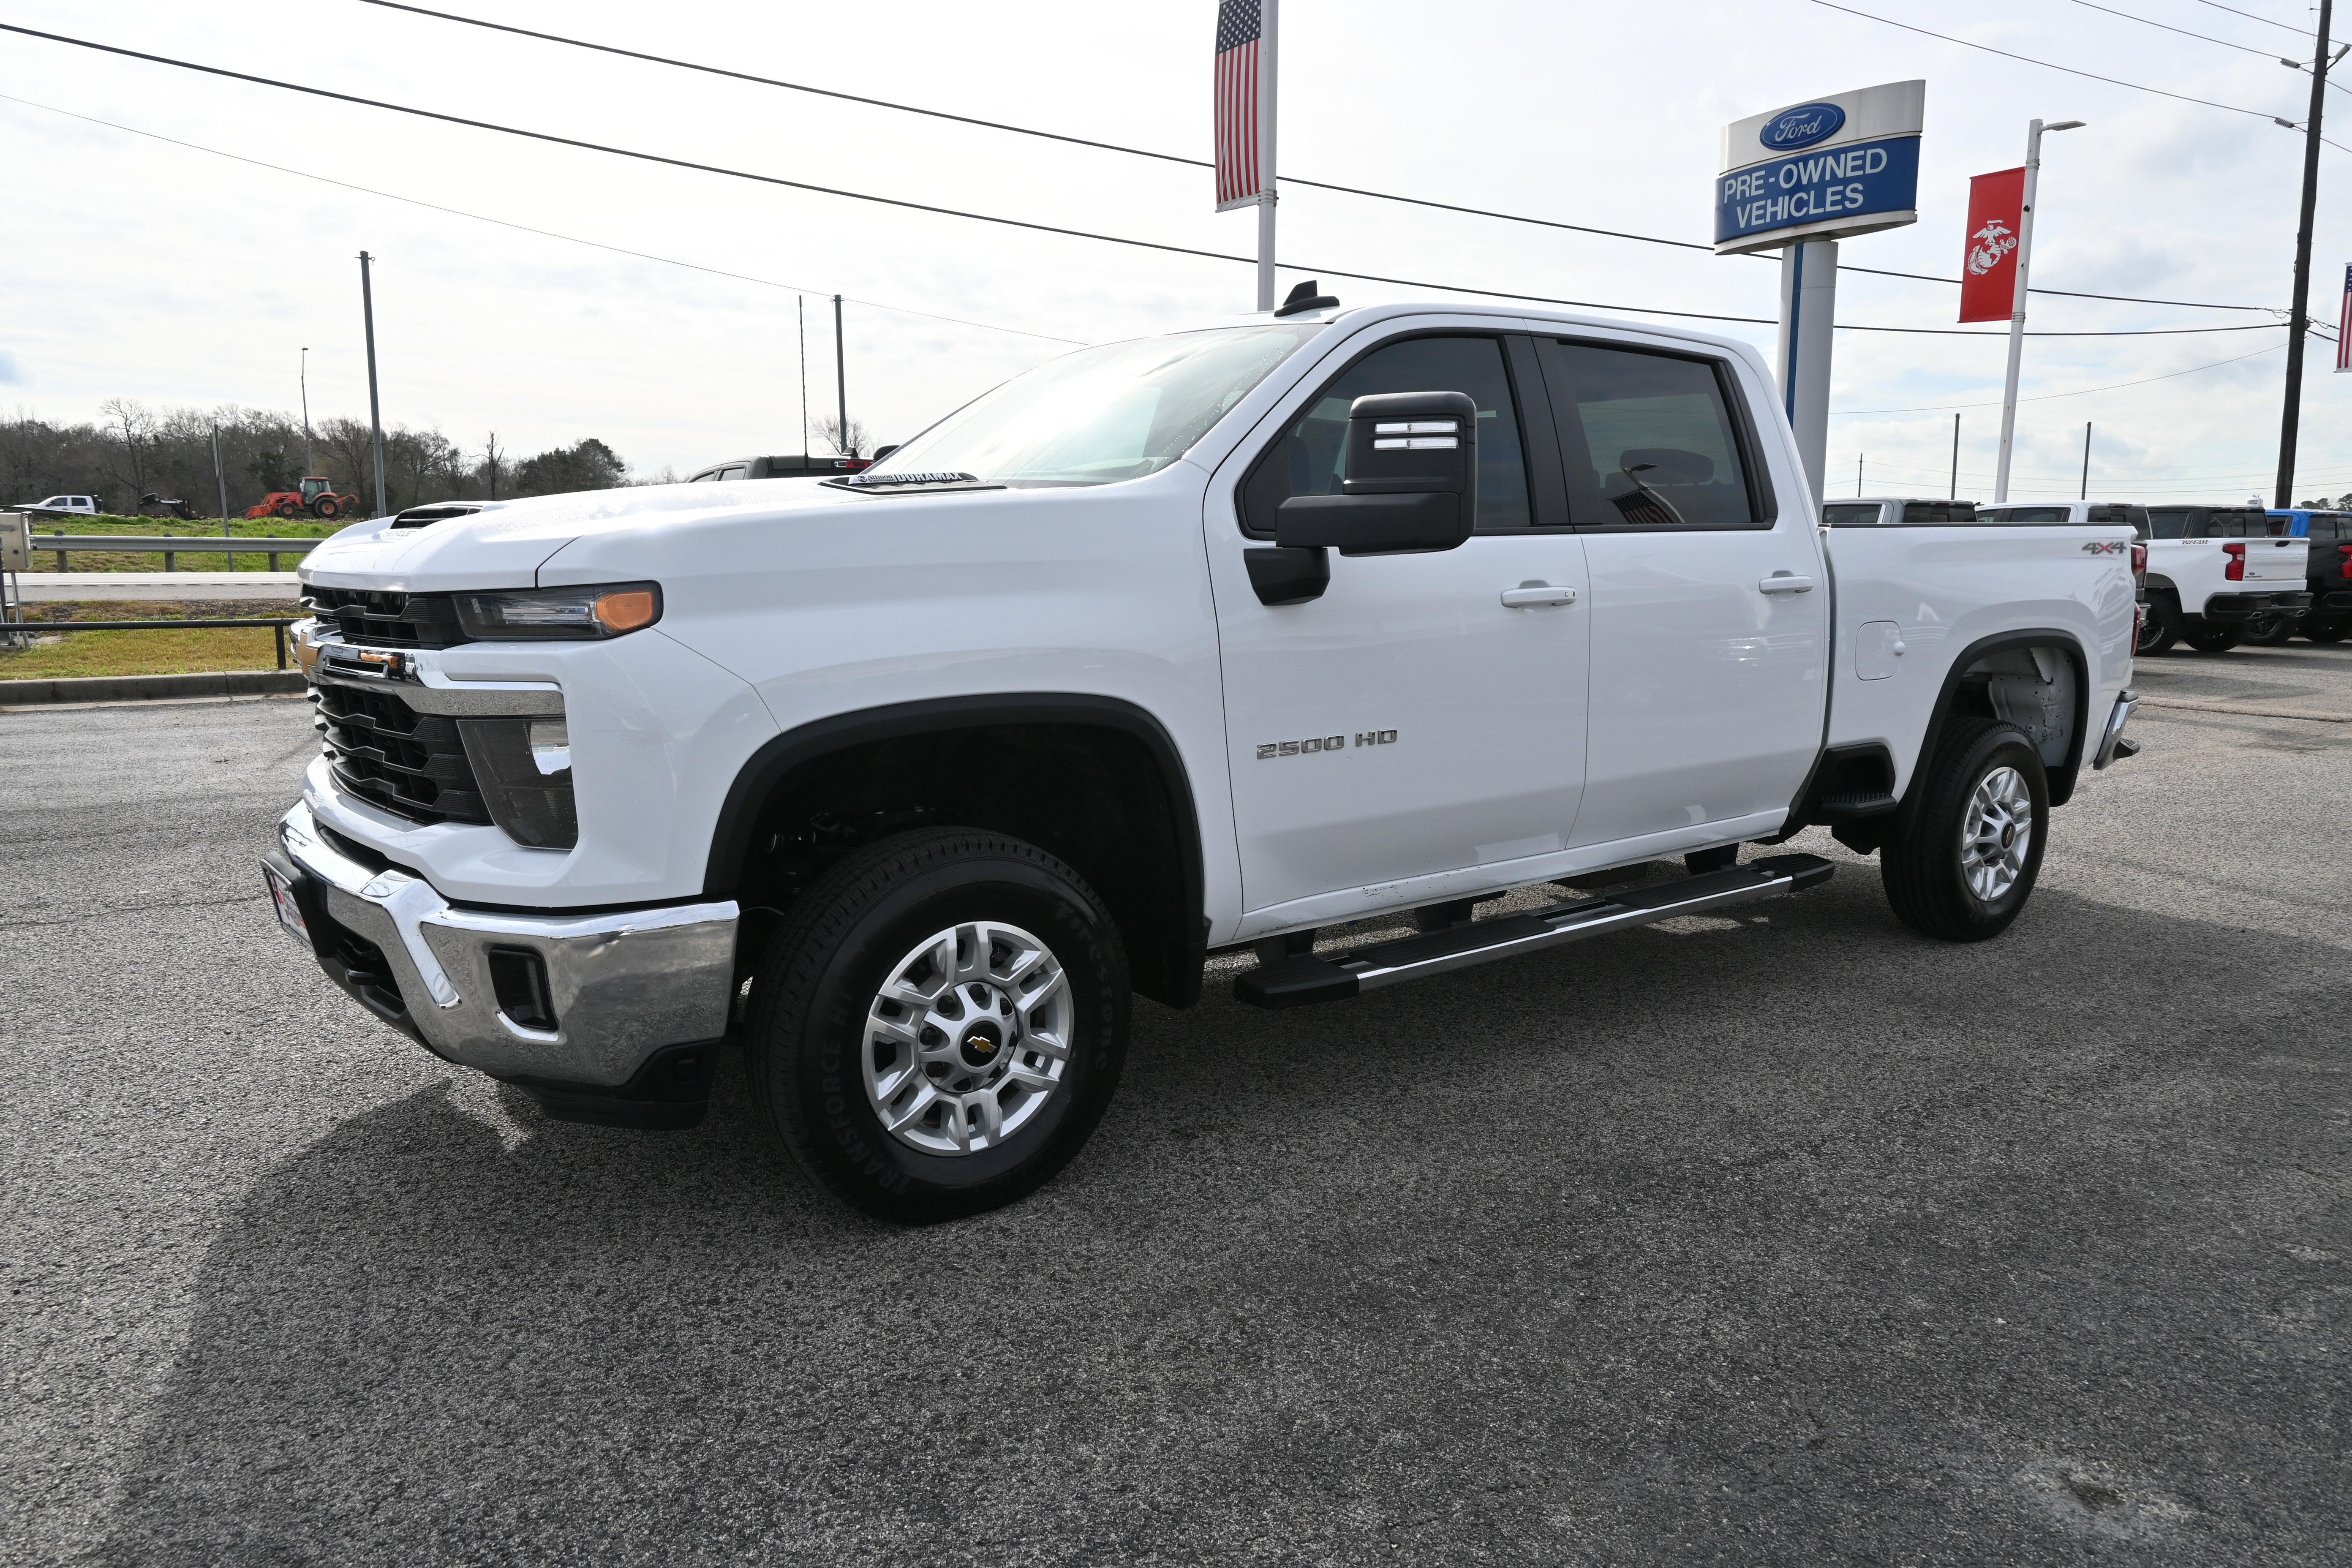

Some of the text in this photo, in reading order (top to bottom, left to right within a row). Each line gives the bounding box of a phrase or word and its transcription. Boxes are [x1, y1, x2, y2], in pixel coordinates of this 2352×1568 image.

[1775, 112, 1822, 142] Ford
[1737, 183, 1864, 229] VEHICLES
[896, 472, 962, 482] DURAMAX
[1257, 729, 1397, 760] 2500 HD
[820, 991, 911, 1196] TRANSFORCE HT
